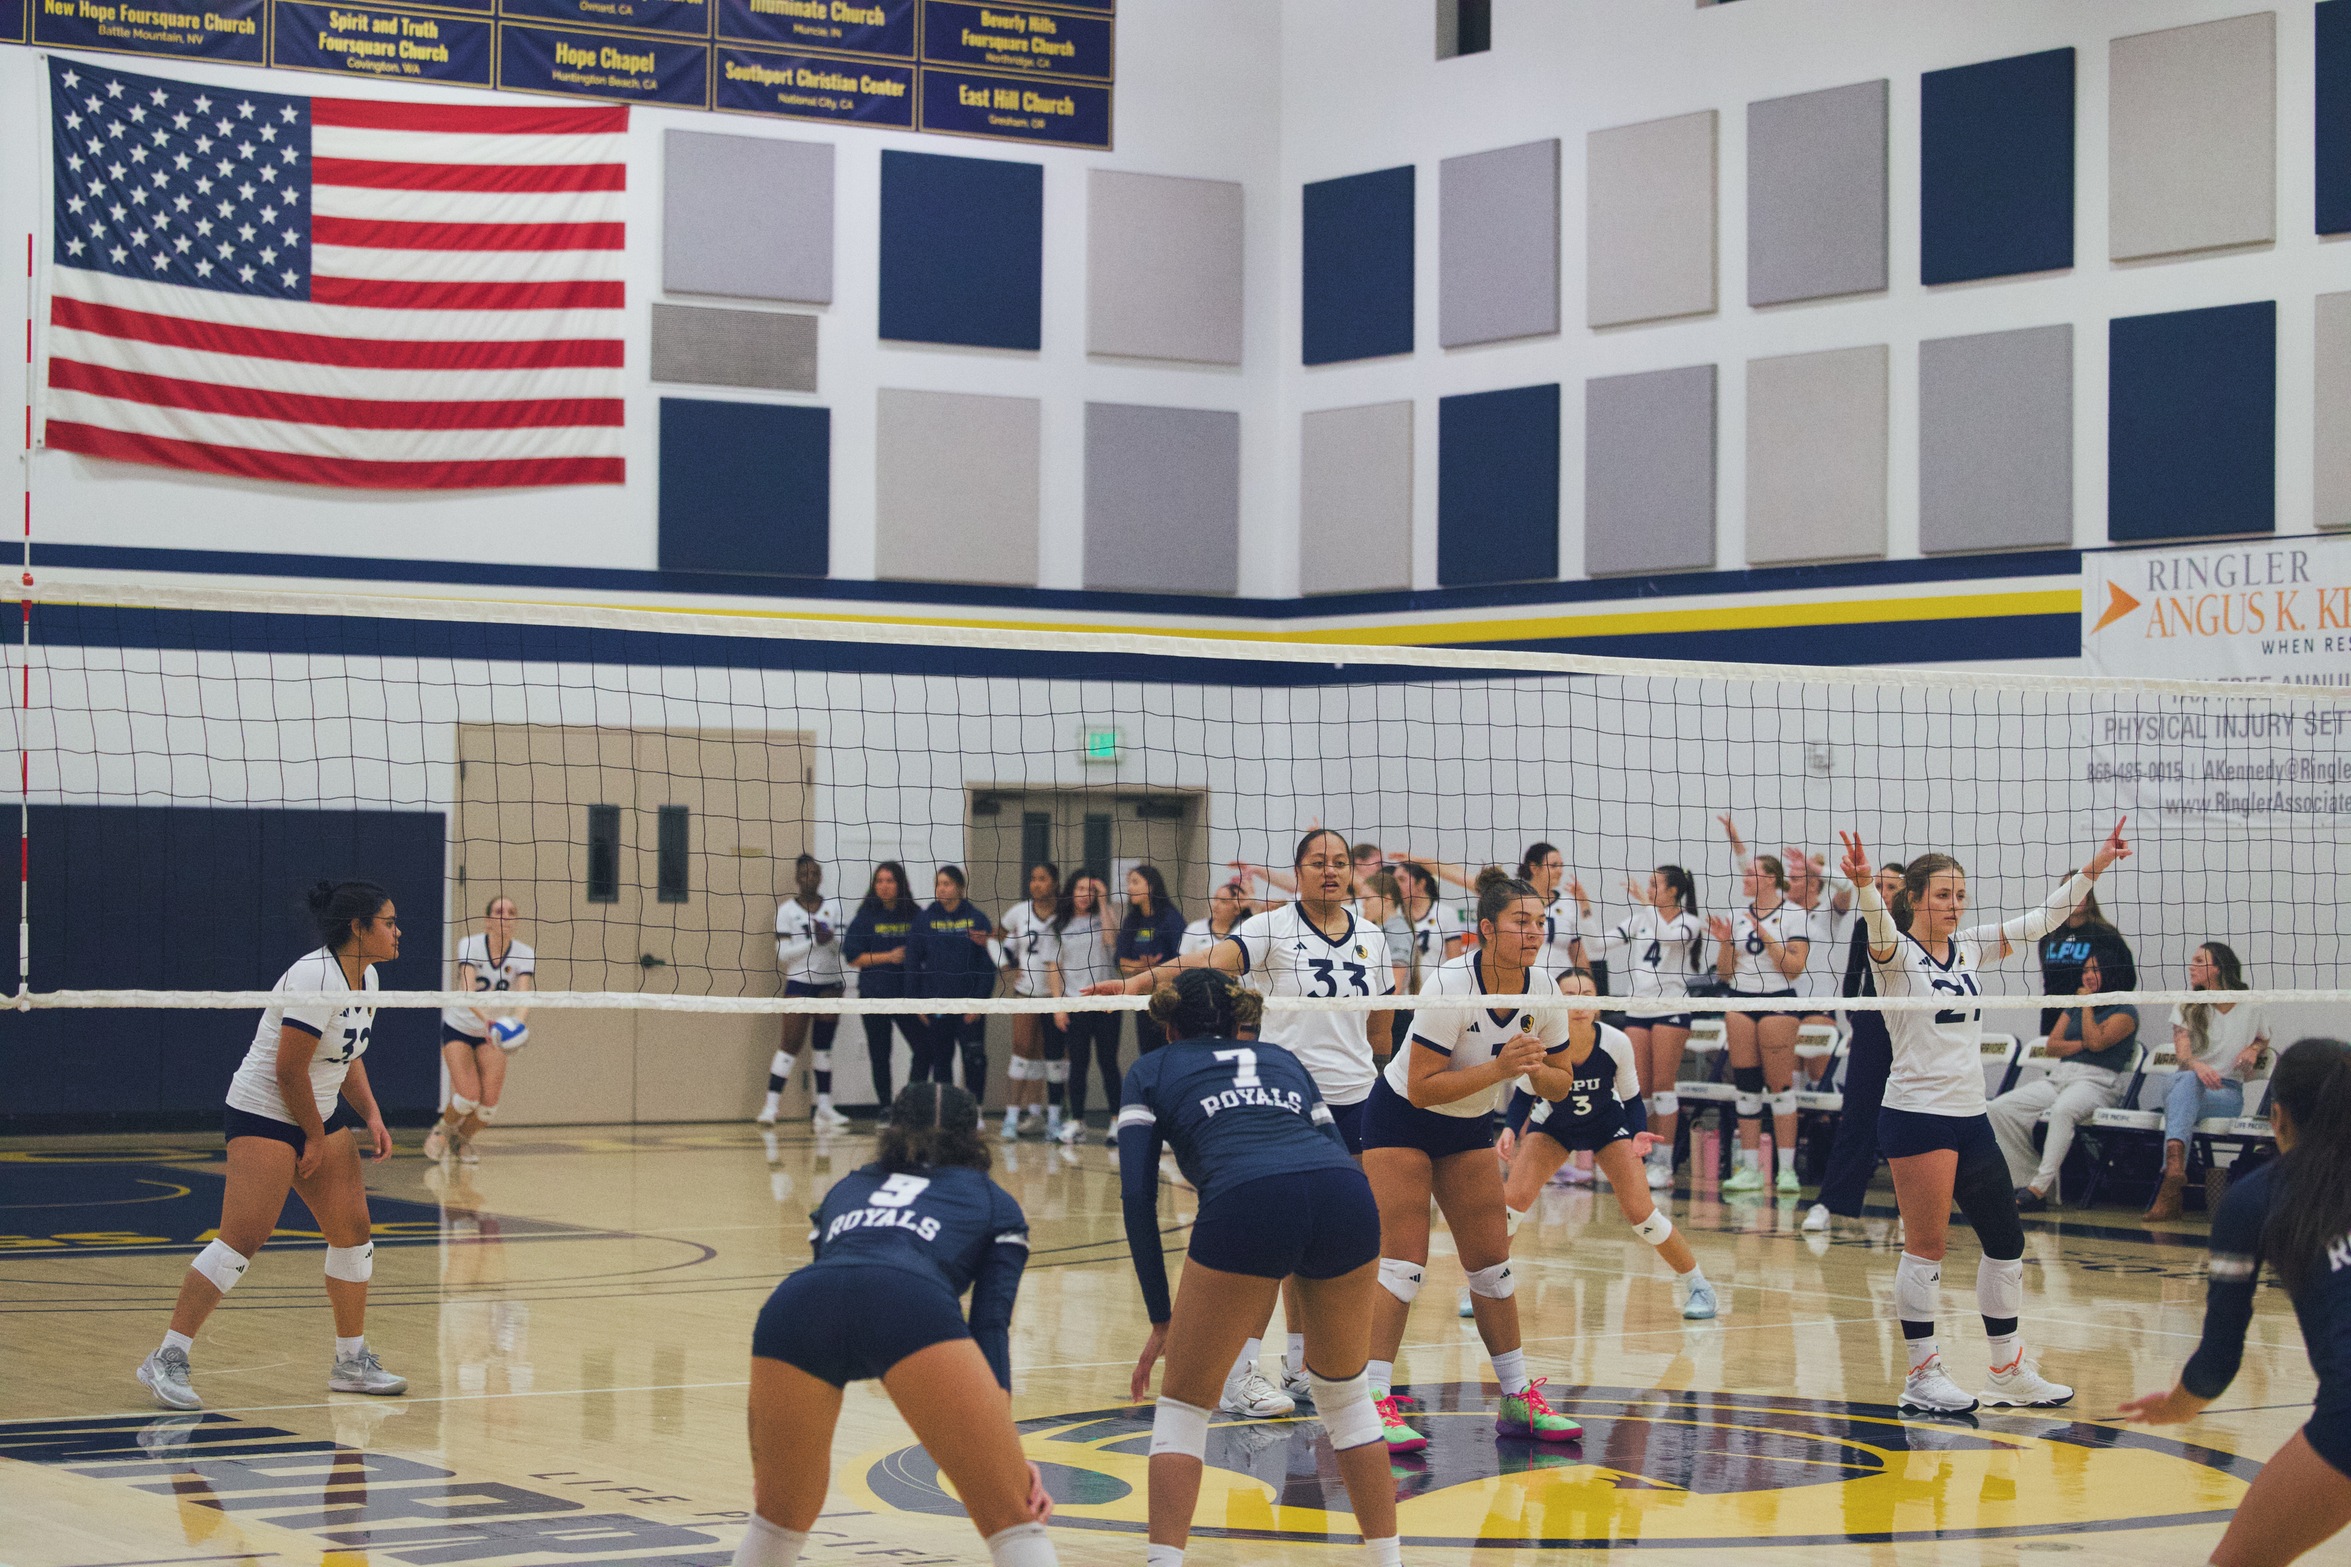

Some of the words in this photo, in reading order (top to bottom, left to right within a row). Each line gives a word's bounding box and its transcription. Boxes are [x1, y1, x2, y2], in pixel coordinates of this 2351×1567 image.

[44, 0, 74, 17] New
[79, 0, 115, 22] Hope
[120, 4, 200, 30] Foursquare
[204, 13, 256, 35] Church
[329, 10, 369, 33] Spirit
[372, 18, 398, 35] and
[401, 19, 439, 39] Truth
[831, 1, 885, 26] Church
[980, 10, 1026, 33] Beverly
[1028, 16, 1057, 34] Hills
[98, 25, 130, 38] Battle
[961, 29, 1029, 52] Foursquare
[1031, 37, 1075, 57] Church
[318, 32, 396, 58] Foursquare
[399, 40, 449, 63] Church
[555, 42, 597, 70] Hope
[600, 47, 655, 75] Chapel
[725, 60, 793, 87] Southport
[796, 68, 858, 93] Christian
[860, 75, 906, 97] Center
[959, 84, 990, 108] East
[993, 89, 1020, 111] Hill
[1022, 91, 1075, 116] Church
[2147, 550, 2312, 592] RINGLER
[2144, 590, 2265, 639] ANGUS
[2275, 590, 2306, 632] K.
[2261, 637, 2314, 655] WHEN
[2104, 715, 2207, 742] PHYSICAL
[2216, 711, 2295, 739] INJURY
[2304, 710, 2351, 736] SET
[1643, 940, 1661, 967] 4
[2046, 941, 2091, 960] LPU
[1307, 958, 1370, 997] 33
[1932, 973, 1981, 1024] 21
[1212, 1048, 1261, 1088] 7
[1569, 1078, 1601, 1091] PU
[1200, 1087, 1302, 1118] ROYALS
[1572, 1095, 1593, 1116] 3
[826, 1208, 941, 1243] ROYALS
[528, 1471, 693, 1506] LIFE
